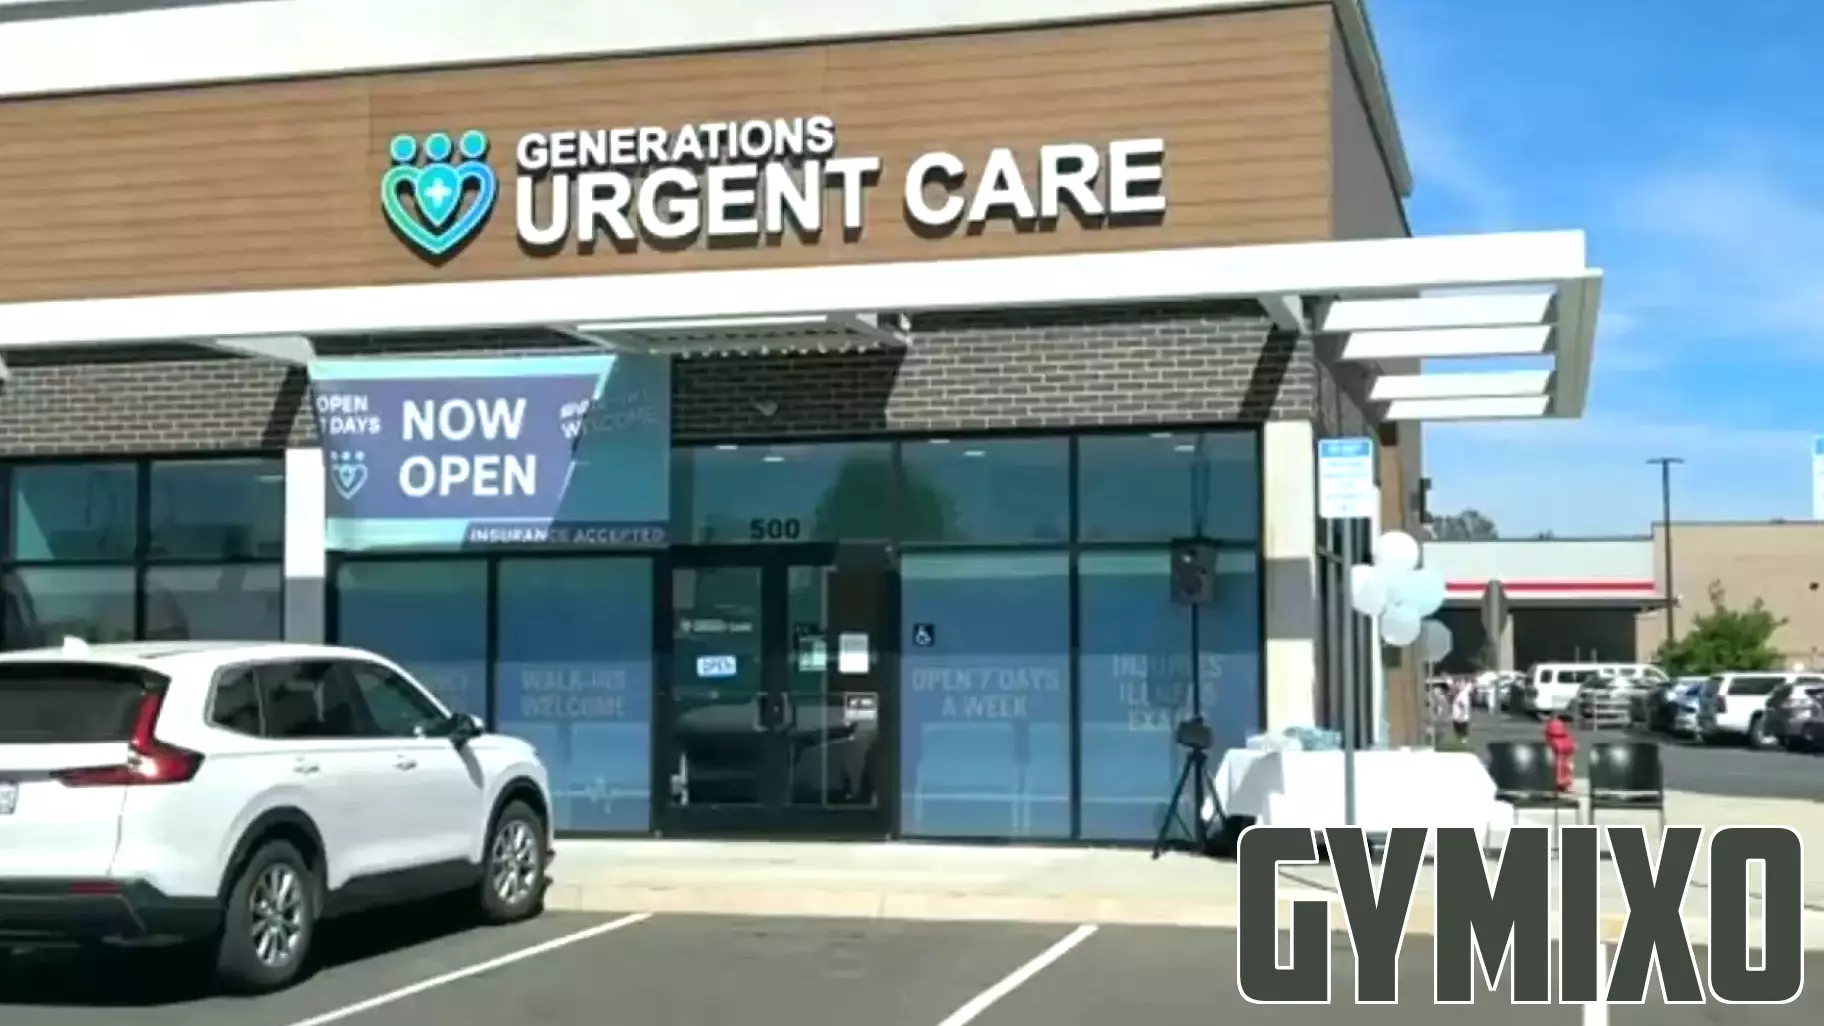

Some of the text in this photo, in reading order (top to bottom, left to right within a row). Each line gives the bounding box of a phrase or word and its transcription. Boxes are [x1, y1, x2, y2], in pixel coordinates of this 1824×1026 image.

[517, 115, 836, 169] GENERATIONS
[516, 138, 1167, 246] URGENT CARE
[316, 393, 369, 414] OPEN
[329, 415, 383, 436] DAYS
[402, 397, 528, 441] NOW
[398, 453, 537, 498] OPEN
[469, 526, 667, 544] INSURANCE ACCEPTED
[750, 518, 801, 540] 500
[912, 669, 972, 692] OPEN
[999, 668, 1060, 691] DAYS
[940, 695, 1027, 718] A WEEK
